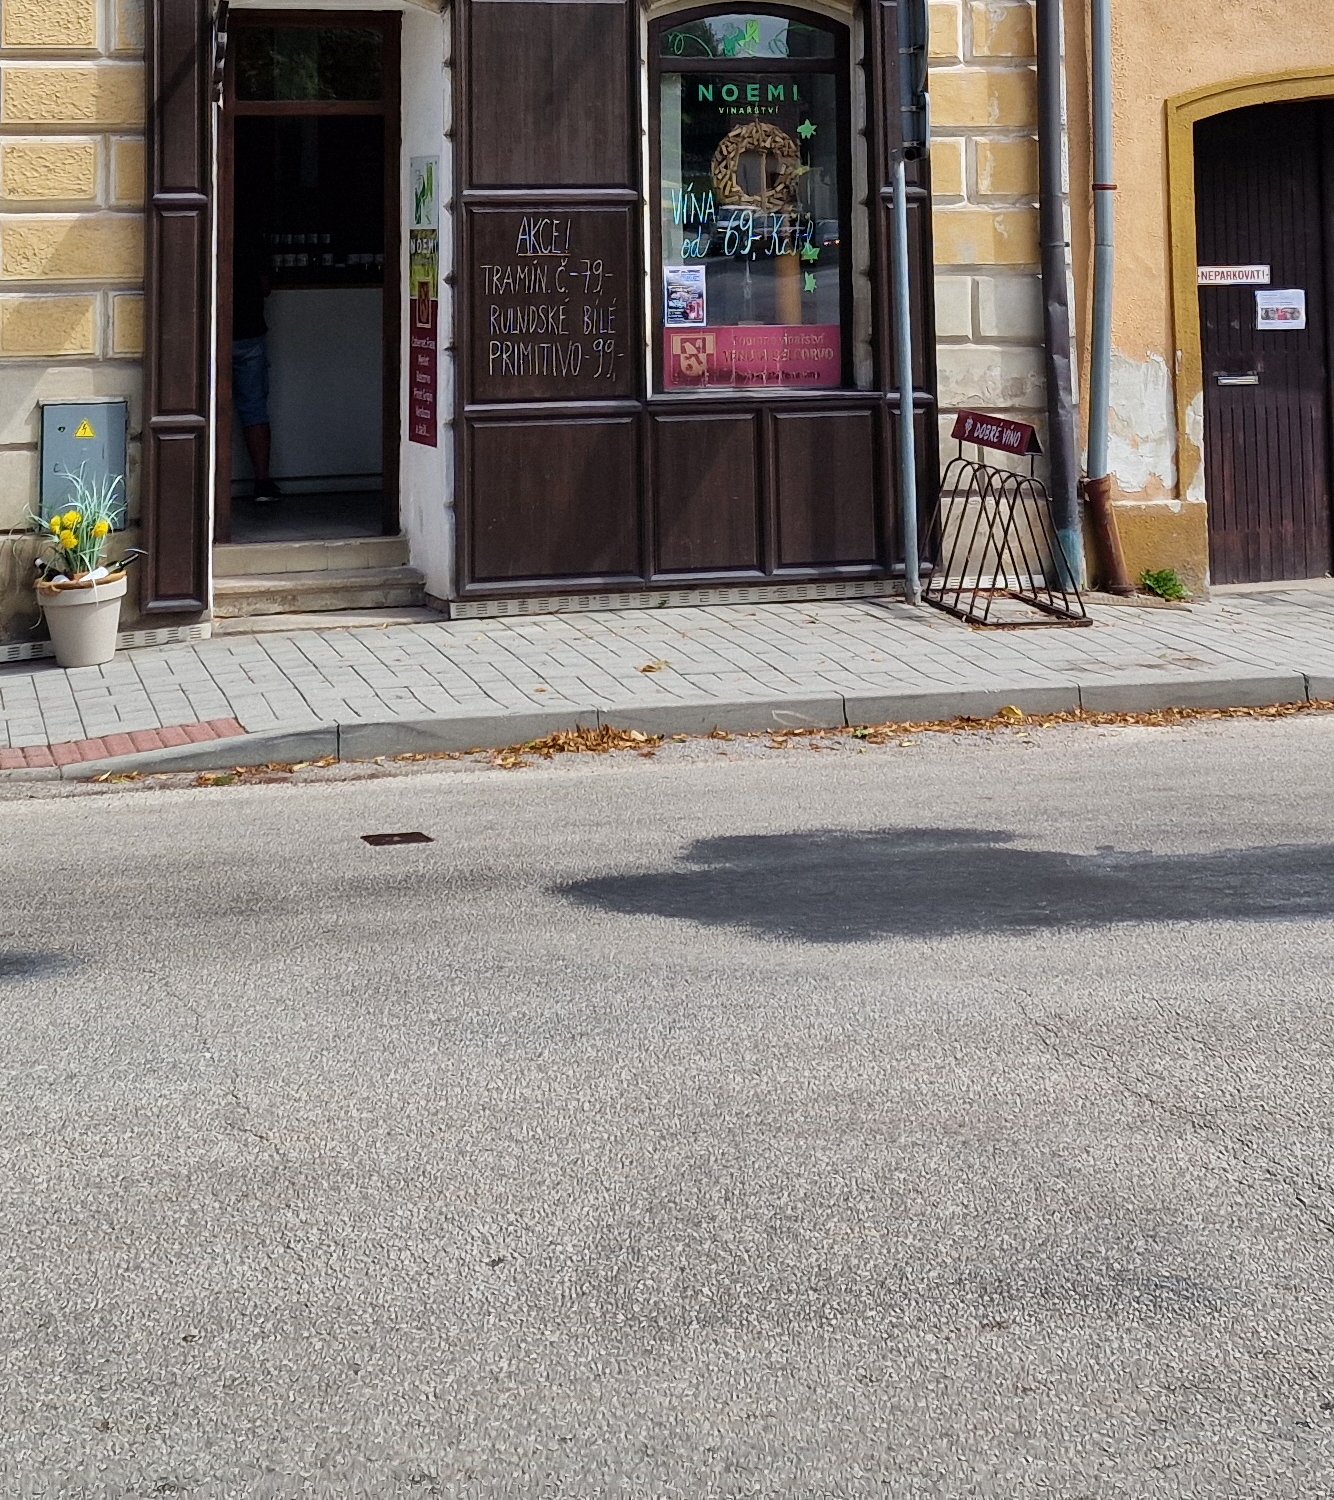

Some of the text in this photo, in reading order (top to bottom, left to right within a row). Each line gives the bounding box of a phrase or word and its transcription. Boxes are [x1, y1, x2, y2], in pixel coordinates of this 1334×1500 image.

[698, 83, 801, 102] NOEMI
[671, 182, 717, 226] VÍNA
[410, 238, 438, 255] NOEMI
[516, 216, 571, 254] AKCE!
[680, 226, 710, 259] od
[583, 297, 617, 335] BÍLÉ
[974, 421, 1021, 448] DOBRÉ VÍNO
